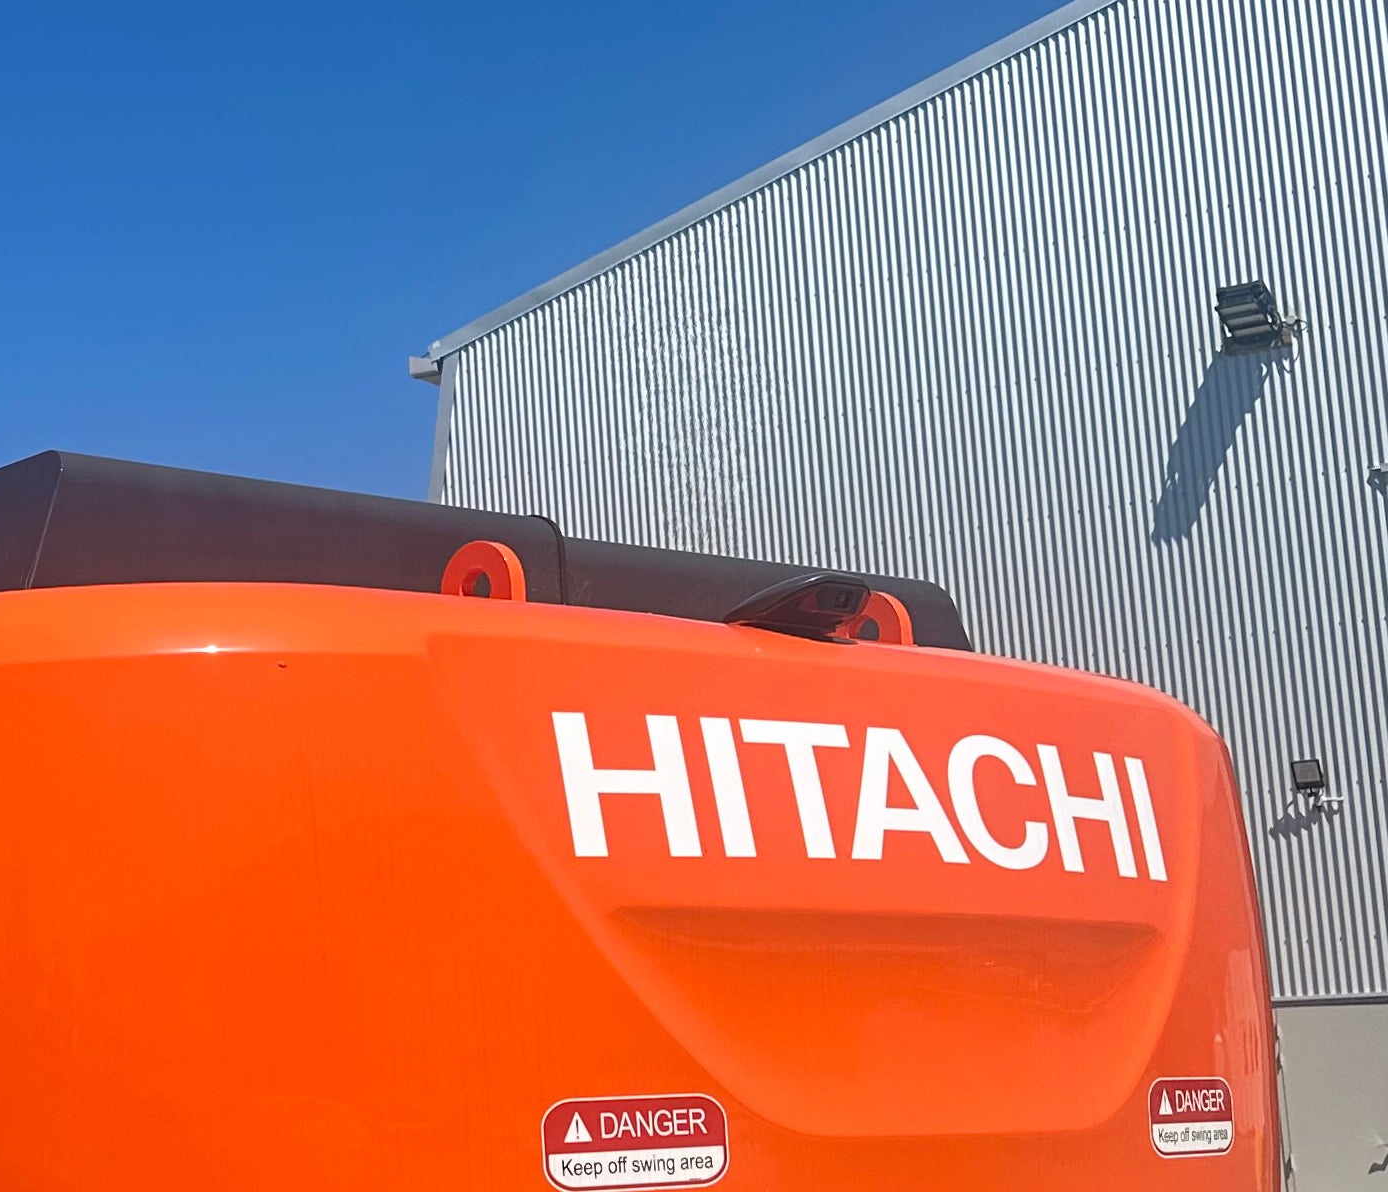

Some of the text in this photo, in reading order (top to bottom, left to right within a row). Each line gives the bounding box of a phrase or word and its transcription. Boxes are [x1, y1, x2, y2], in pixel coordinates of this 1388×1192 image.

[551, 711, 1169, 882] HITACHI
[1175, 1088, 1225, 1112] DANGER
[600, 1108, 707, 1139] DANGER
[1158, 1128, 1178, 1146] Keep
[1180, 1127, 1190, 1142] off
[1213, 1128, 1228, 1140] area
[562, 1154, 714, 1179] Keep off swing area
